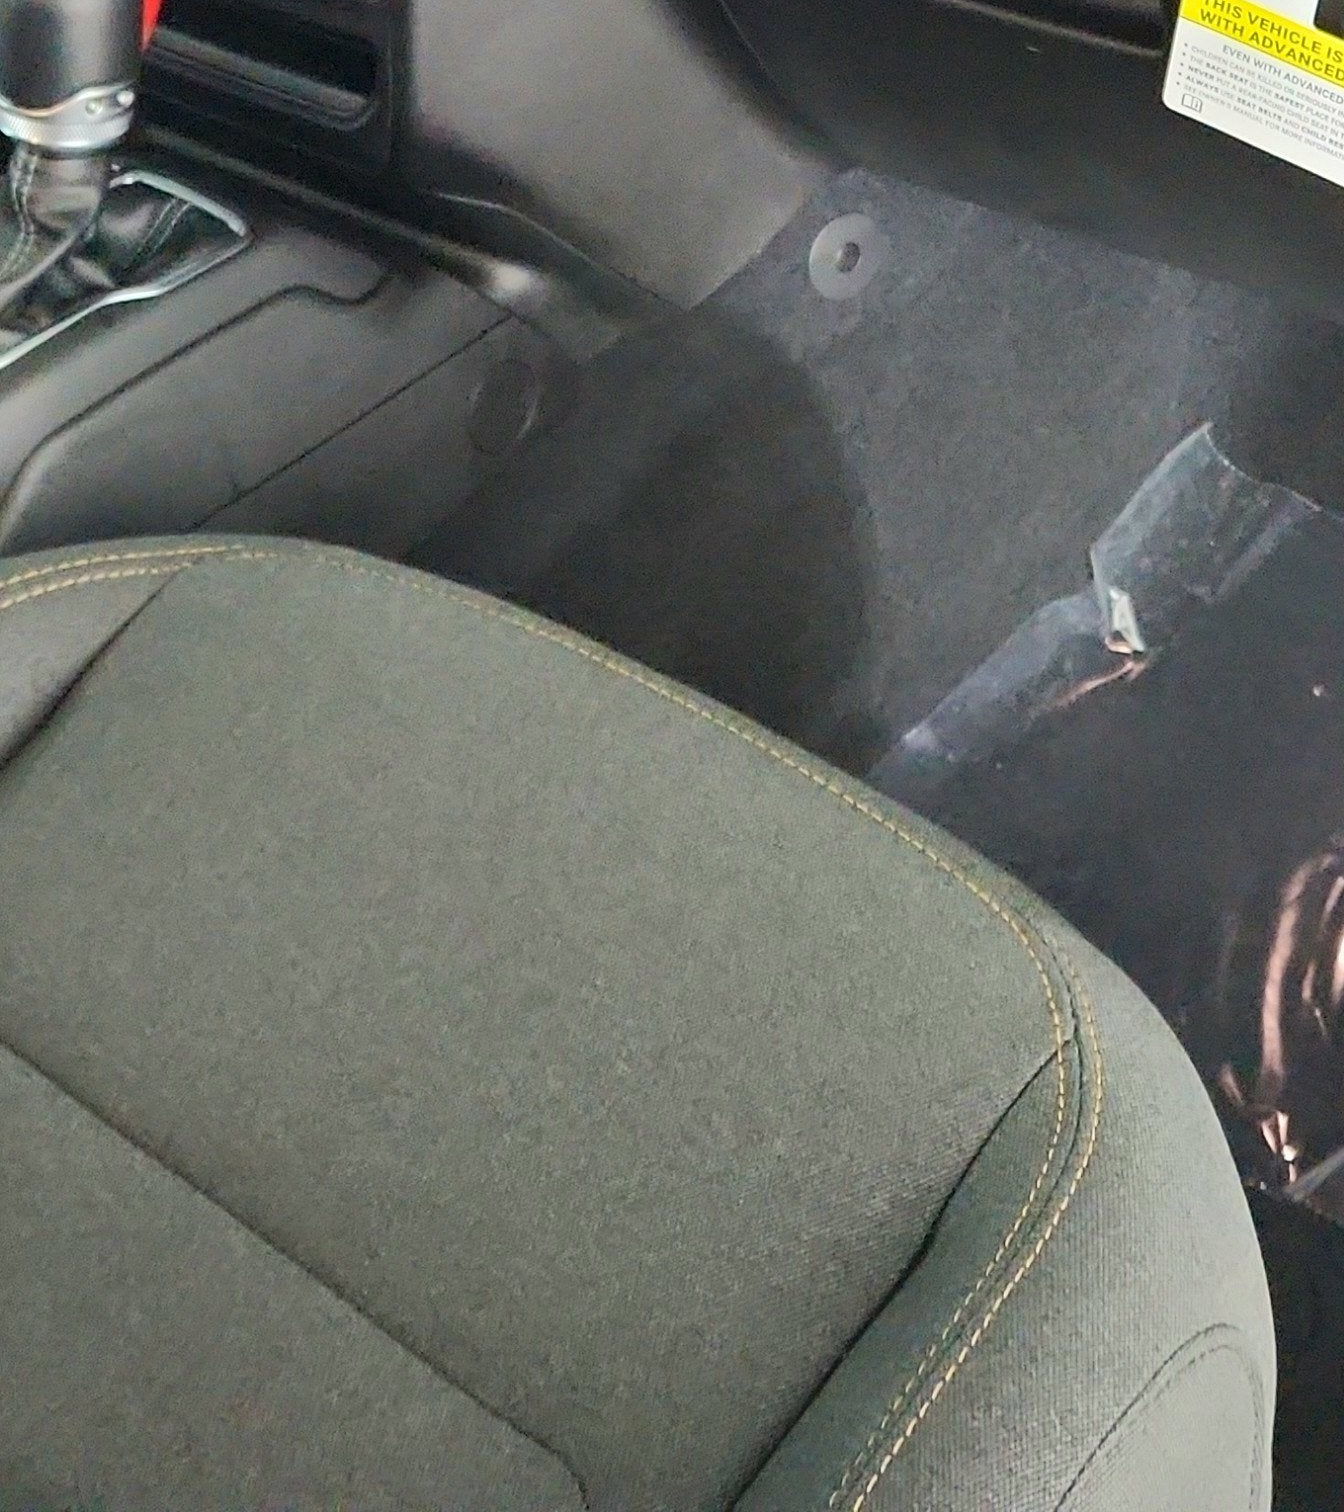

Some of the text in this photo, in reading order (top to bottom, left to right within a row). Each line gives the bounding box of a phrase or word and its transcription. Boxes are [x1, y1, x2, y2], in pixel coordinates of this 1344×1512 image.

[1199, 7, 1244, 37] WITH
[1246, 11, 1321, 54] VEHICLE
[1326, 46, 1343, 63] IS
[1188, 64, 1214, 81] NEVER
[1310, 119, 1328, 132] SEAT
[1190, 54, 1203, 65] THE
[1205, 61, 1226, 75] BACK
[1229, 72, 1248, 85] SEAT
[1258, 85, 1272, 96] THE
[1274, 92, 1303, 110] SAFEST
[1305, 106, 1328, 122] PLACE
[1330, 117, 1344, 129] FOR
[1191, 44, 1228, 66] CHILDREN
[1228, 61, 1245, 74] CAN
[1257, 74, 1282, 91] KILLED
[1296, 91, 1336, 115] SERIOUSLY
[1222, 44, 1250, 63] EVEN
[1253, 58, 1281, 77] WITH
[1283, 71, 1344, 105] ADVANCED
[1186, 73, 1219, 93] ALWAYS
[1236, 96, 1256, 110] SEAT
[1257, 106, 1281, 122] BELTS
[1283, 117, 1299, 130] AND
[1300, 125, 1326, 142] CHILD
[1232, 105, 1263, 124] MANUAL
